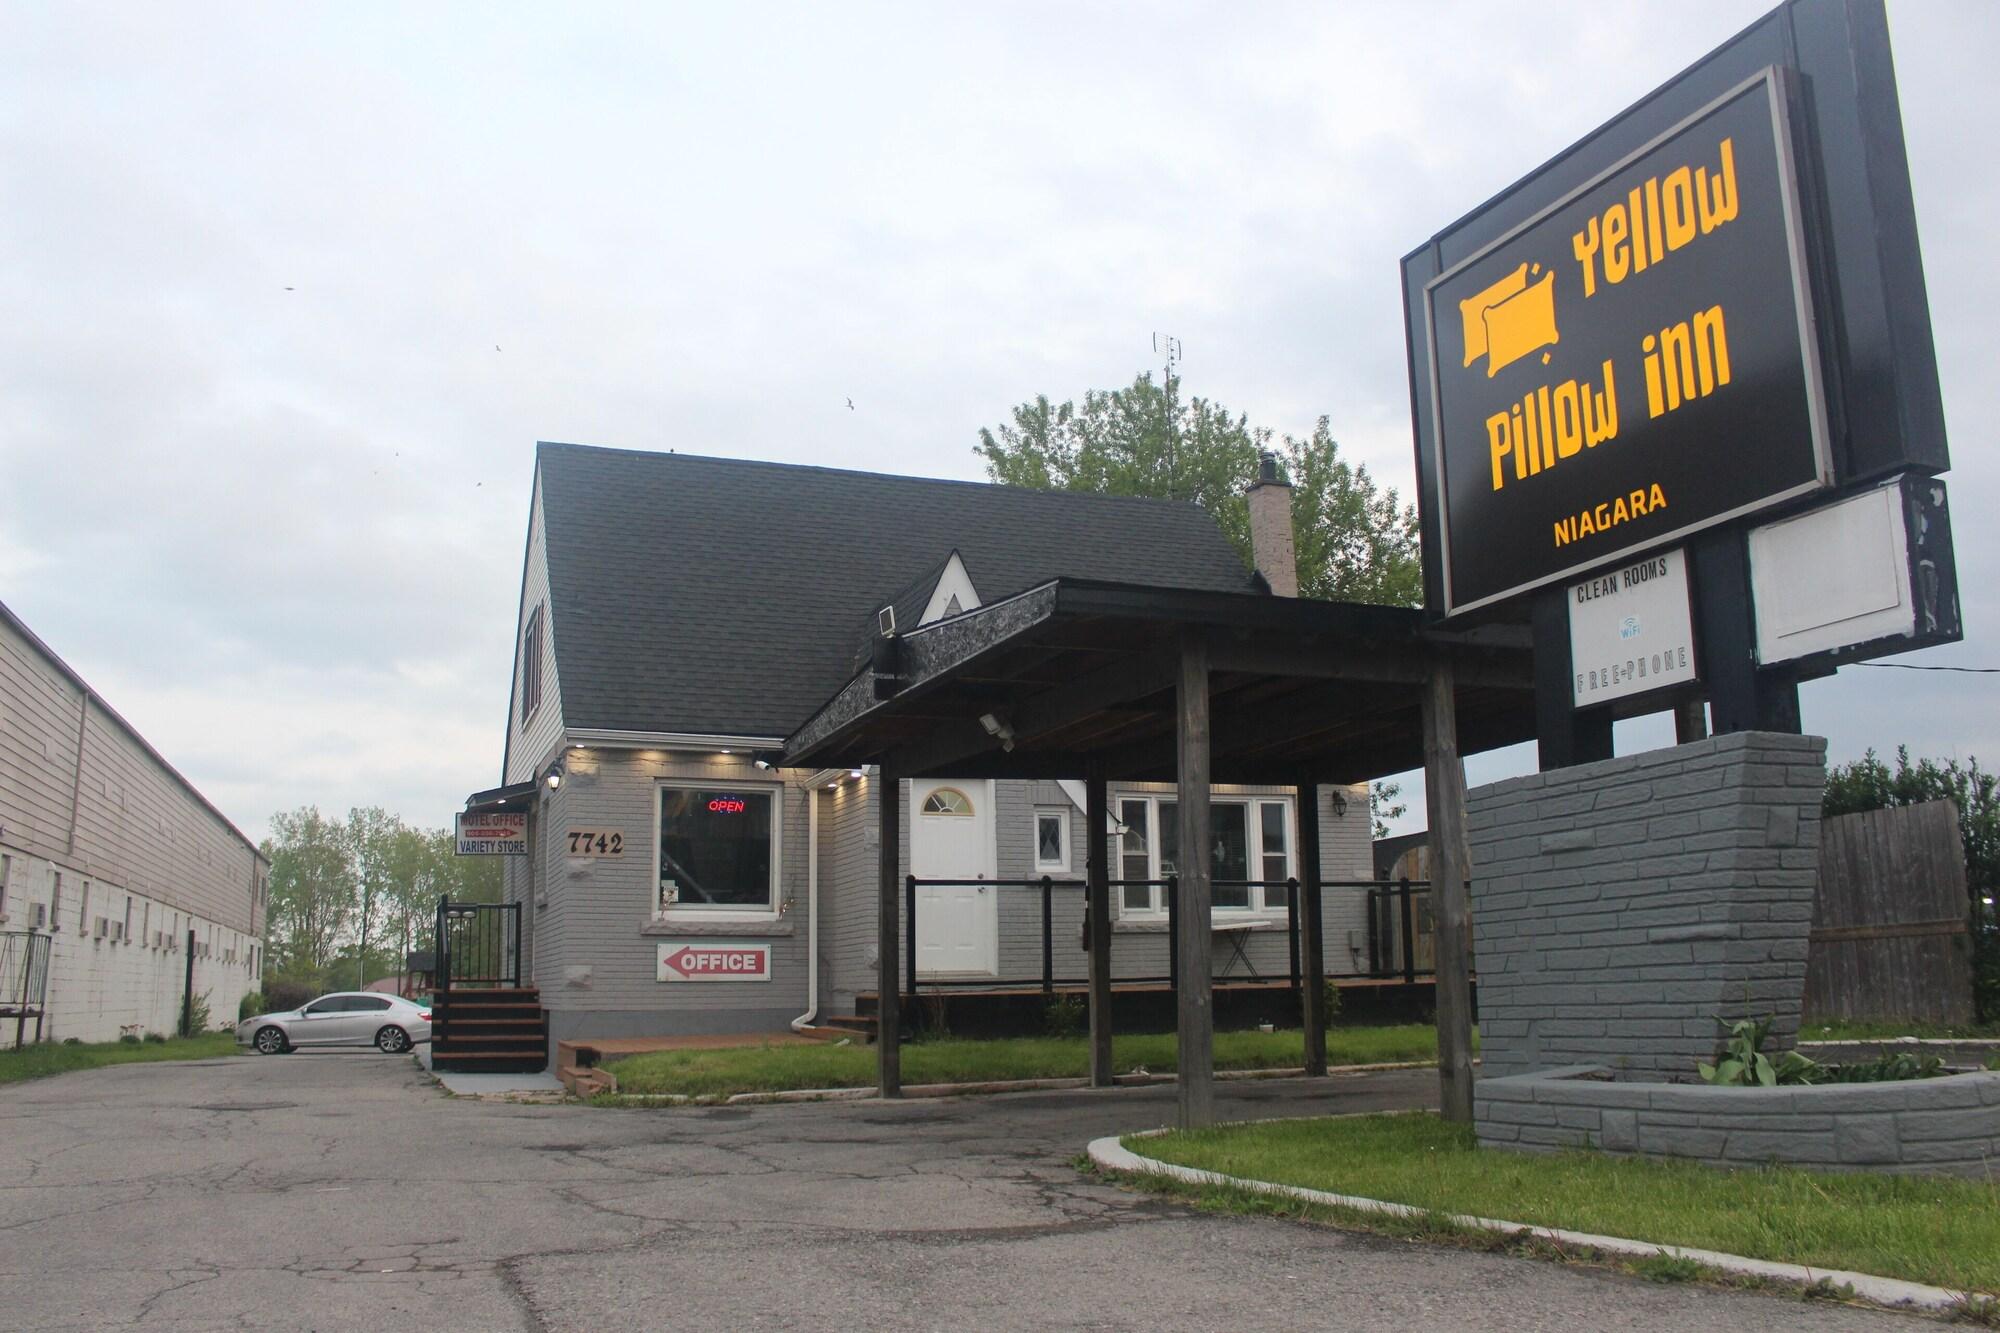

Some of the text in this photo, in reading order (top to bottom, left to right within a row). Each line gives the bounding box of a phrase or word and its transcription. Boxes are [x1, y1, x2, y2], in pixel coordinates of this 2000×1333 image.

[1572, 138, 1739, 298] Yellow
[1486, 360, 1619, 491] Pillow
[1553, 483, 1667, 546] NIAGARA
[1577, 558, 1667, 603] CLEAN ROOMS
[709, 800, 744, 812] OPEN
[461, 814, 524, 826] MOTEL OFFICE
[460, 840, 525, 853] VARIETY STORE
[568, 832, 623, 854] 7742
[681, 953, 756, 970] OFFICE
